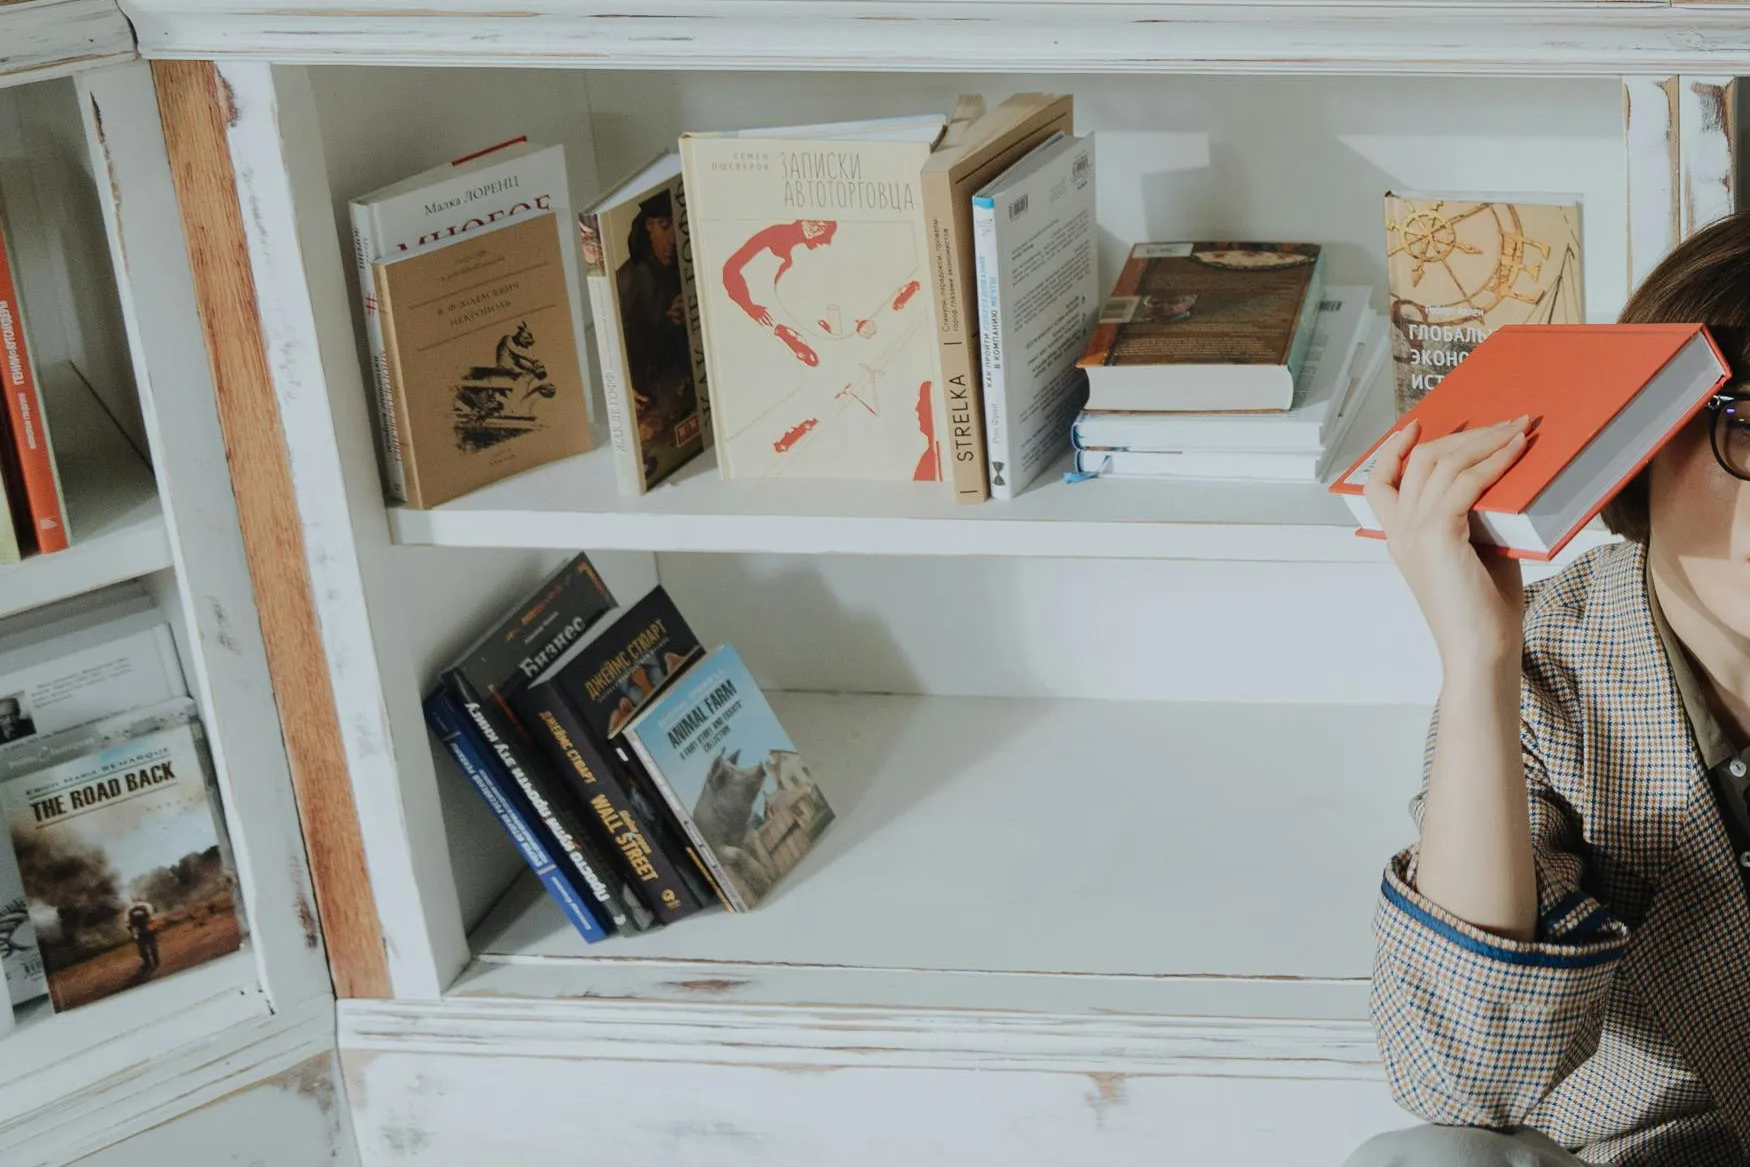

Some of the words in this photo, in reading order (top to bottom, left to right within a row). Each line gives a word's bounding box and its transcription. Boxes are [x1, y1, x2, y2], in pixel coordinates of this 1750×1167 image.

[781, 151, 862, 180] ЗАПИСКИ
[784, 179, 915, 211] АВТОТОРГОВЦА
[951, 374, 974, 462] STRELKA
[666, 697, 708, 750] ANIMAL
[704, 679, 738, 716] FARM
[32, 794, 67, 822] THE
[71, 779, 122, 811] ROAD
[126, 762, 175, 793] BACK
[591, 794, 623, 833] WALL
[616, 834, 658, 882] STREET
